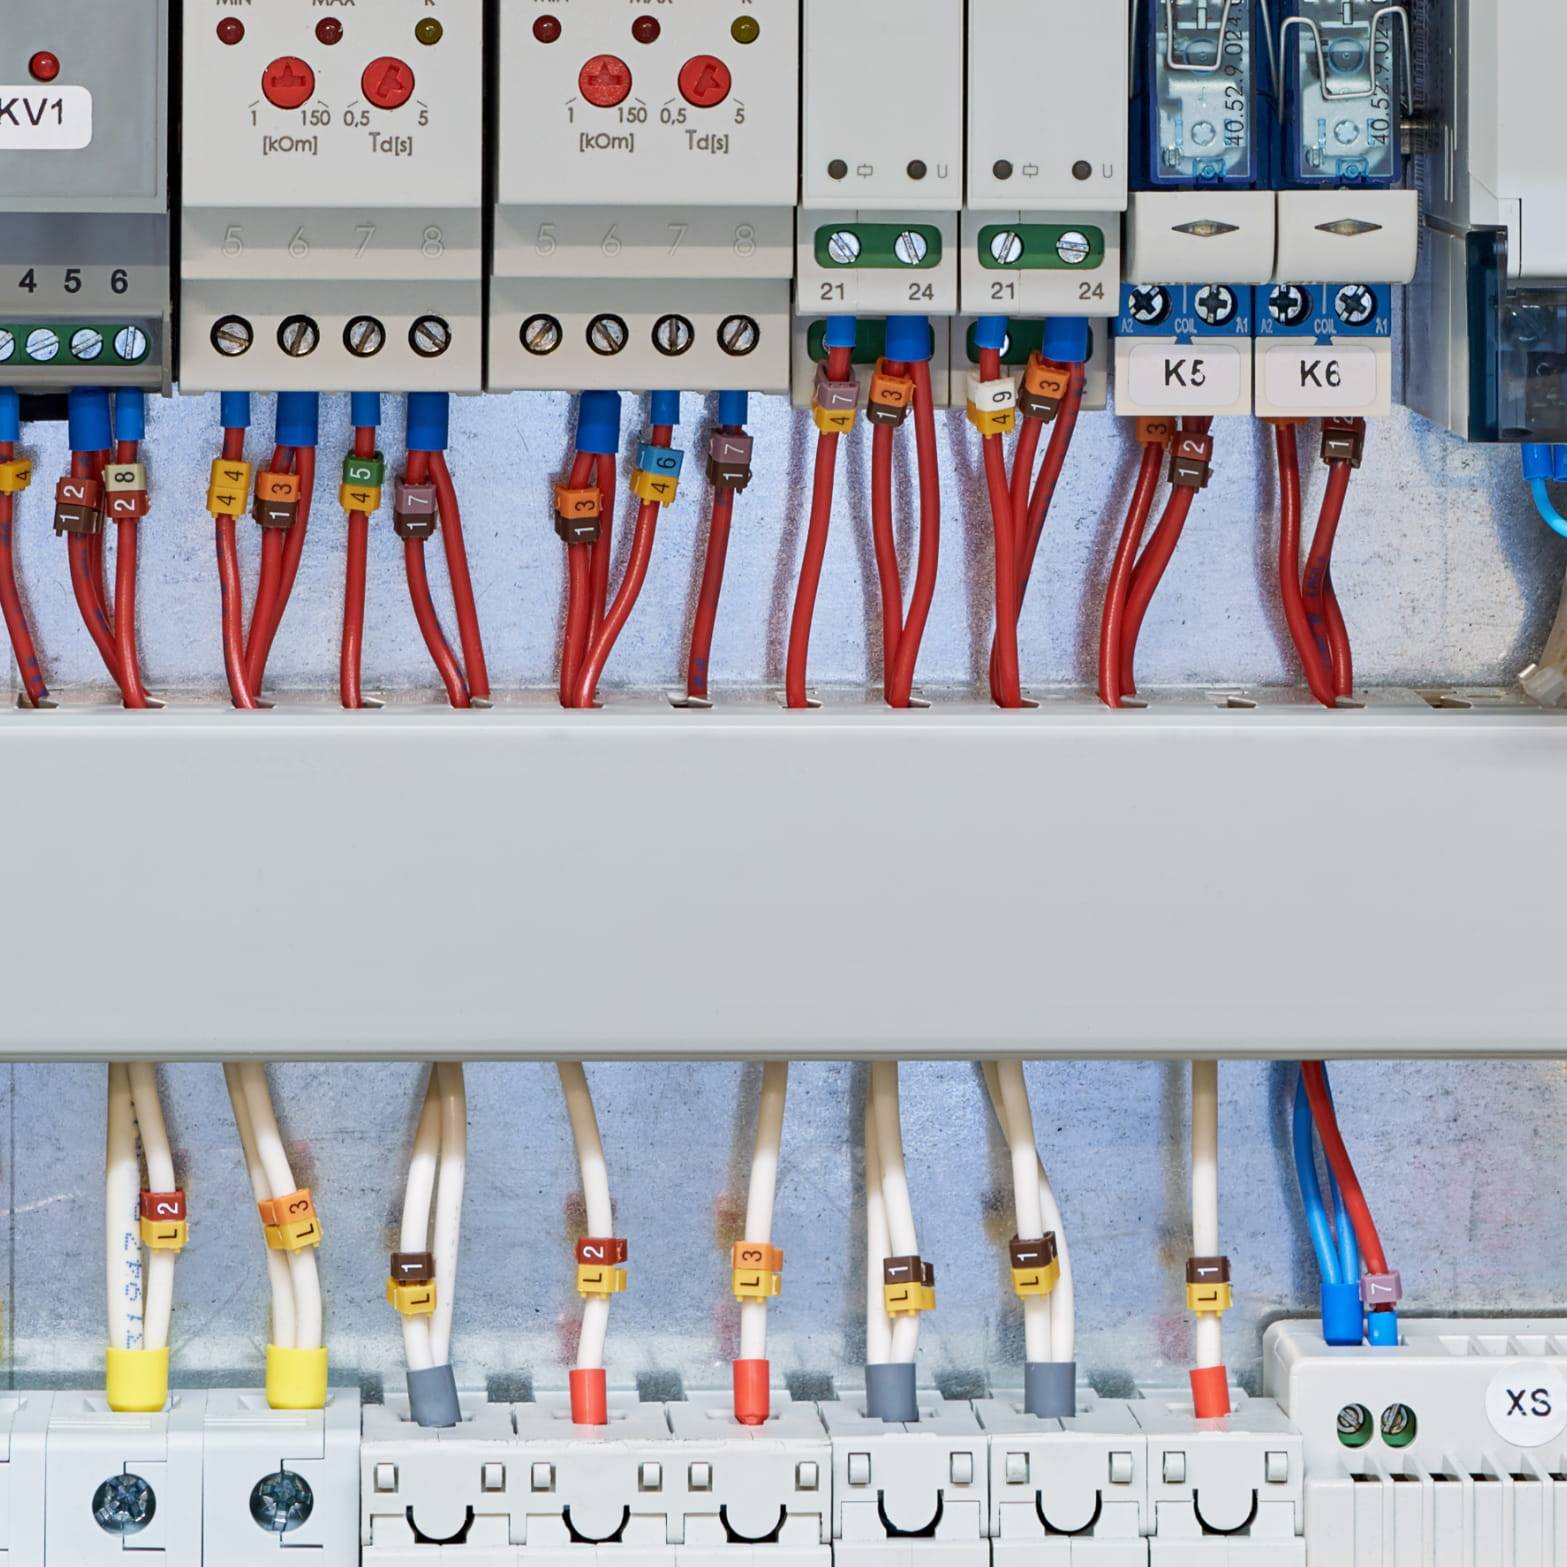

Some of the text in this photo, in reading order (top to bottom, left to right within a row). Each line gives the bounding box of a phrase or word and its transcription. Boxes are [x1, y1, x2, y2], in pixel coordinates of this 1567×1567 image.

[302, 110, 370, 128] 150 0,5
[618, 107, 687, 125] 150 0,5
[18, 268, 37, 293] 4
[64, 268, 82, 293] 5
[111, 269, 128, 294] 6
[821, 283, 934, 301] 21 24
[991, 282, 1104, 300] 21 24
[1164, 359, 1206, 387] K5
[1299, 359, 1341, 387] K6
[1506, 1388, 1552, 1417] XS
